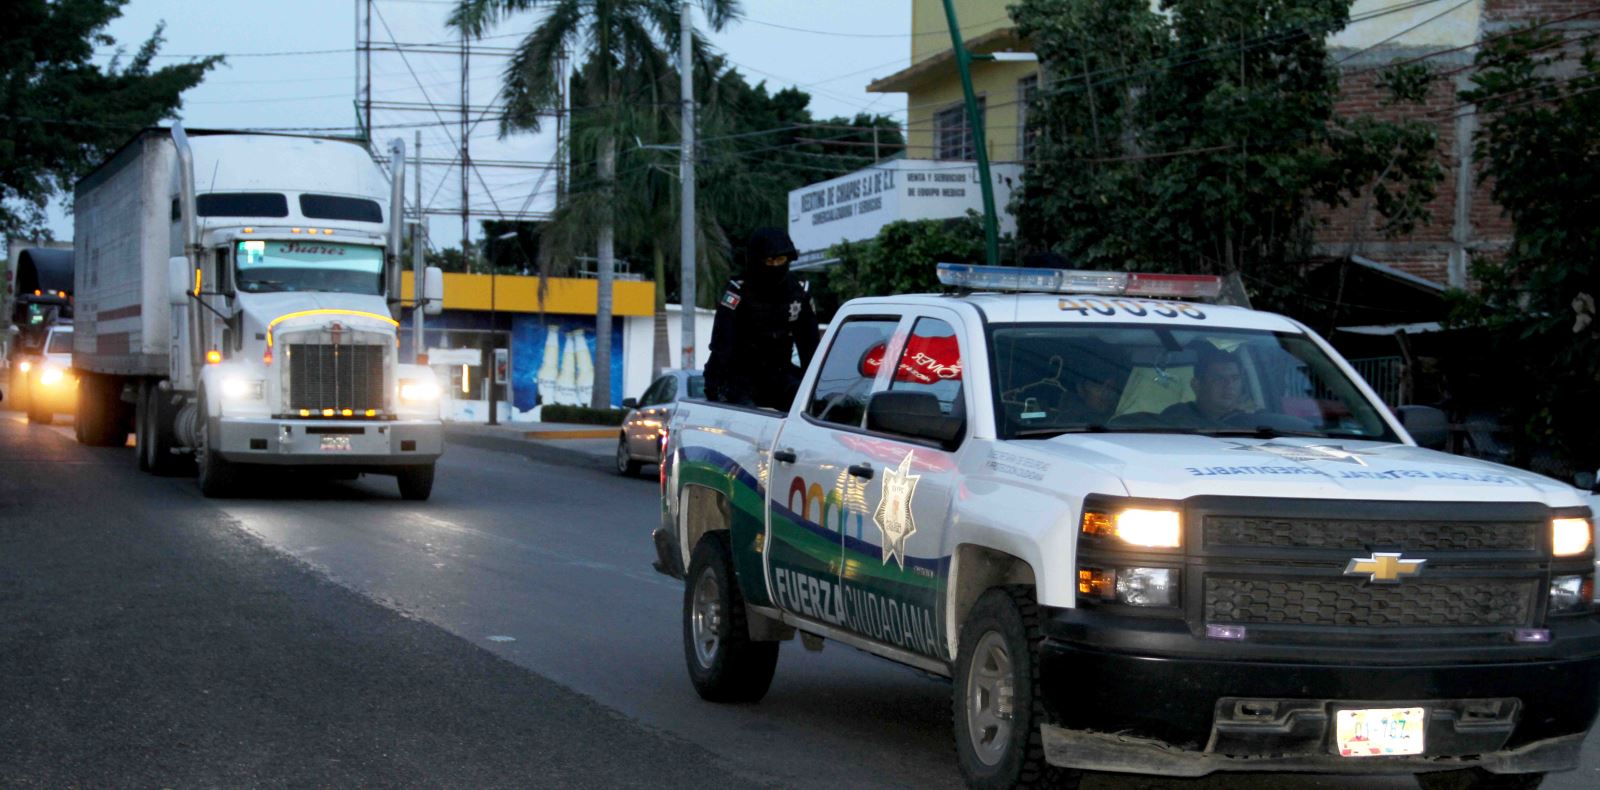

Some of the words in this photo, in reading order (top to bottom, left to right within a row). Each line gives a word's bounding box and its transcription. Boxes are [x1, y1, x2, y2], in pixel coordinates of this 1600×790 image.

[907, 173, 925, 182] VENTA
[934, 173, 966, 182] SERVICIOS
[908, 188, 915, 196] DE
[917, 188, 940, 196] EQUIPO
[775, 568, 846, 625] FUERZA
[844, 585, 940, 658] CIUDADANA
